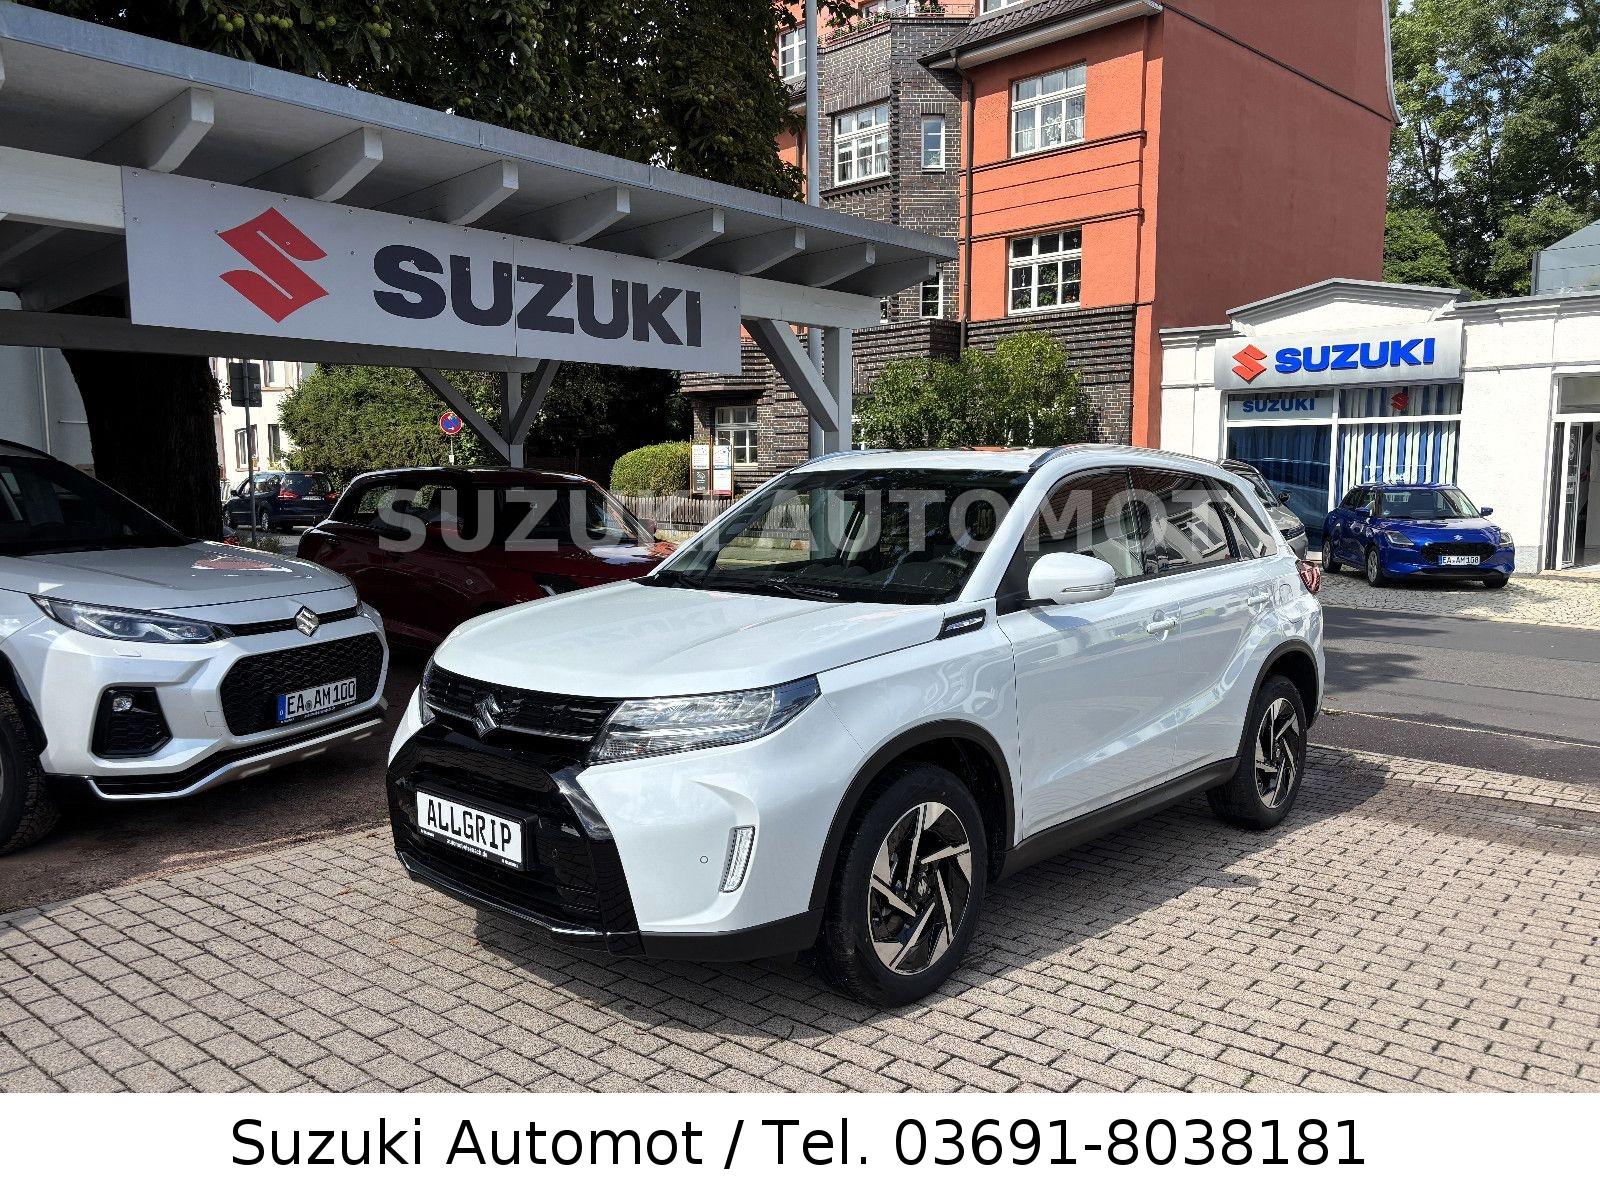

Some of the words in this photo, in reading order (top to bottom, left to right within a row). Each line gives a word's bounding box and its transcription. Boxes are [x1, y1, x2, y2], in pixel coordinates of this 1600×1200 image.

[373, 244, 702, 348] SUZUKI
[1274, 338, 1436, 374] SUZUKI
[1242, 398, 1316, 413] SUZUKI
[287, 693, 305, 716] EA
[313, 686, 331, 709] AM
[333, 680, 356, 704] 100
[427, 798, 512, 852] ALLGRIP
